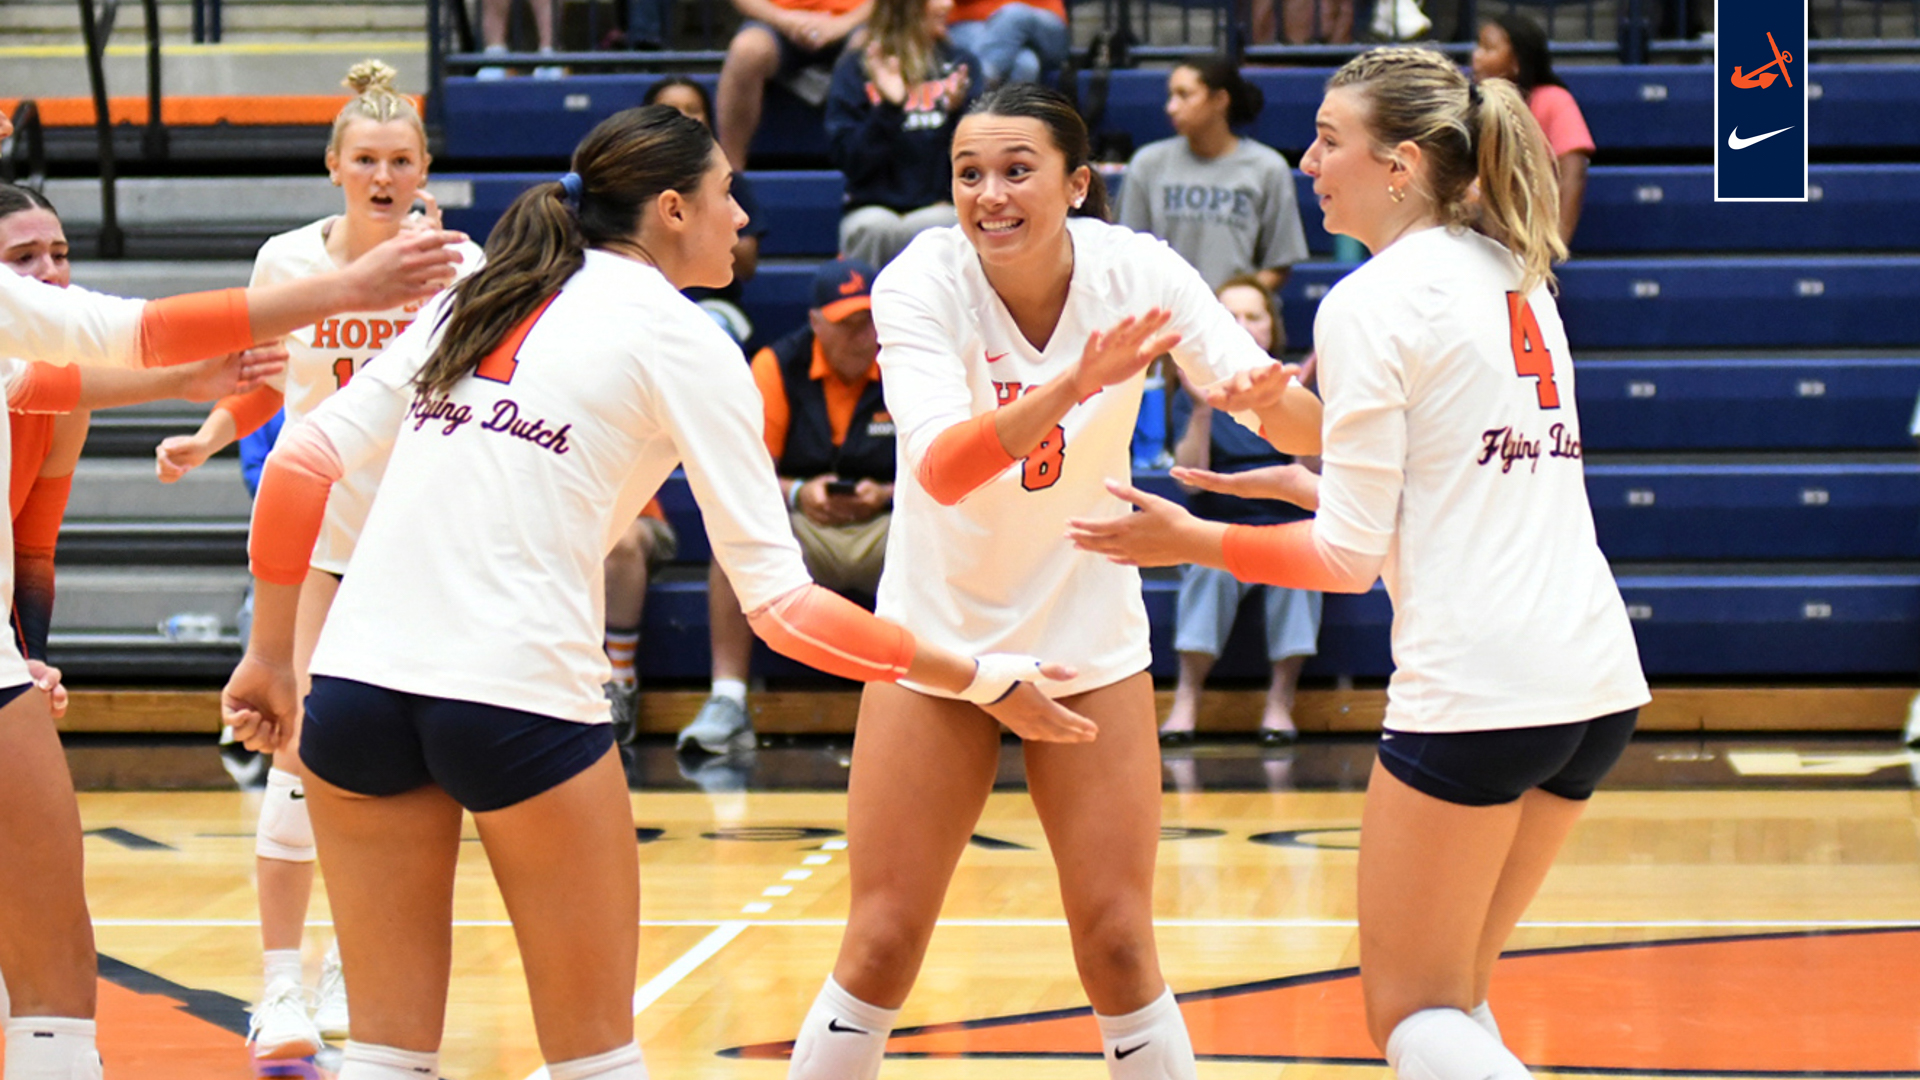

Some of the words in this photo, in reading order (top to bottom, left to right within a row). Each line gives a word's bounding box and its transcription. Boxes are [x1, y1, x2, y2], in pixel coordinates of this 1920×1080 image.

[1163, 184, 1254, 216] HOPE
[1505, 289, 1561, 410] 4
[480, 399, 572, 454] Dutch
[1477, 425, 1541, 474] Flying
[1021, 423, 1067, 492] 8
